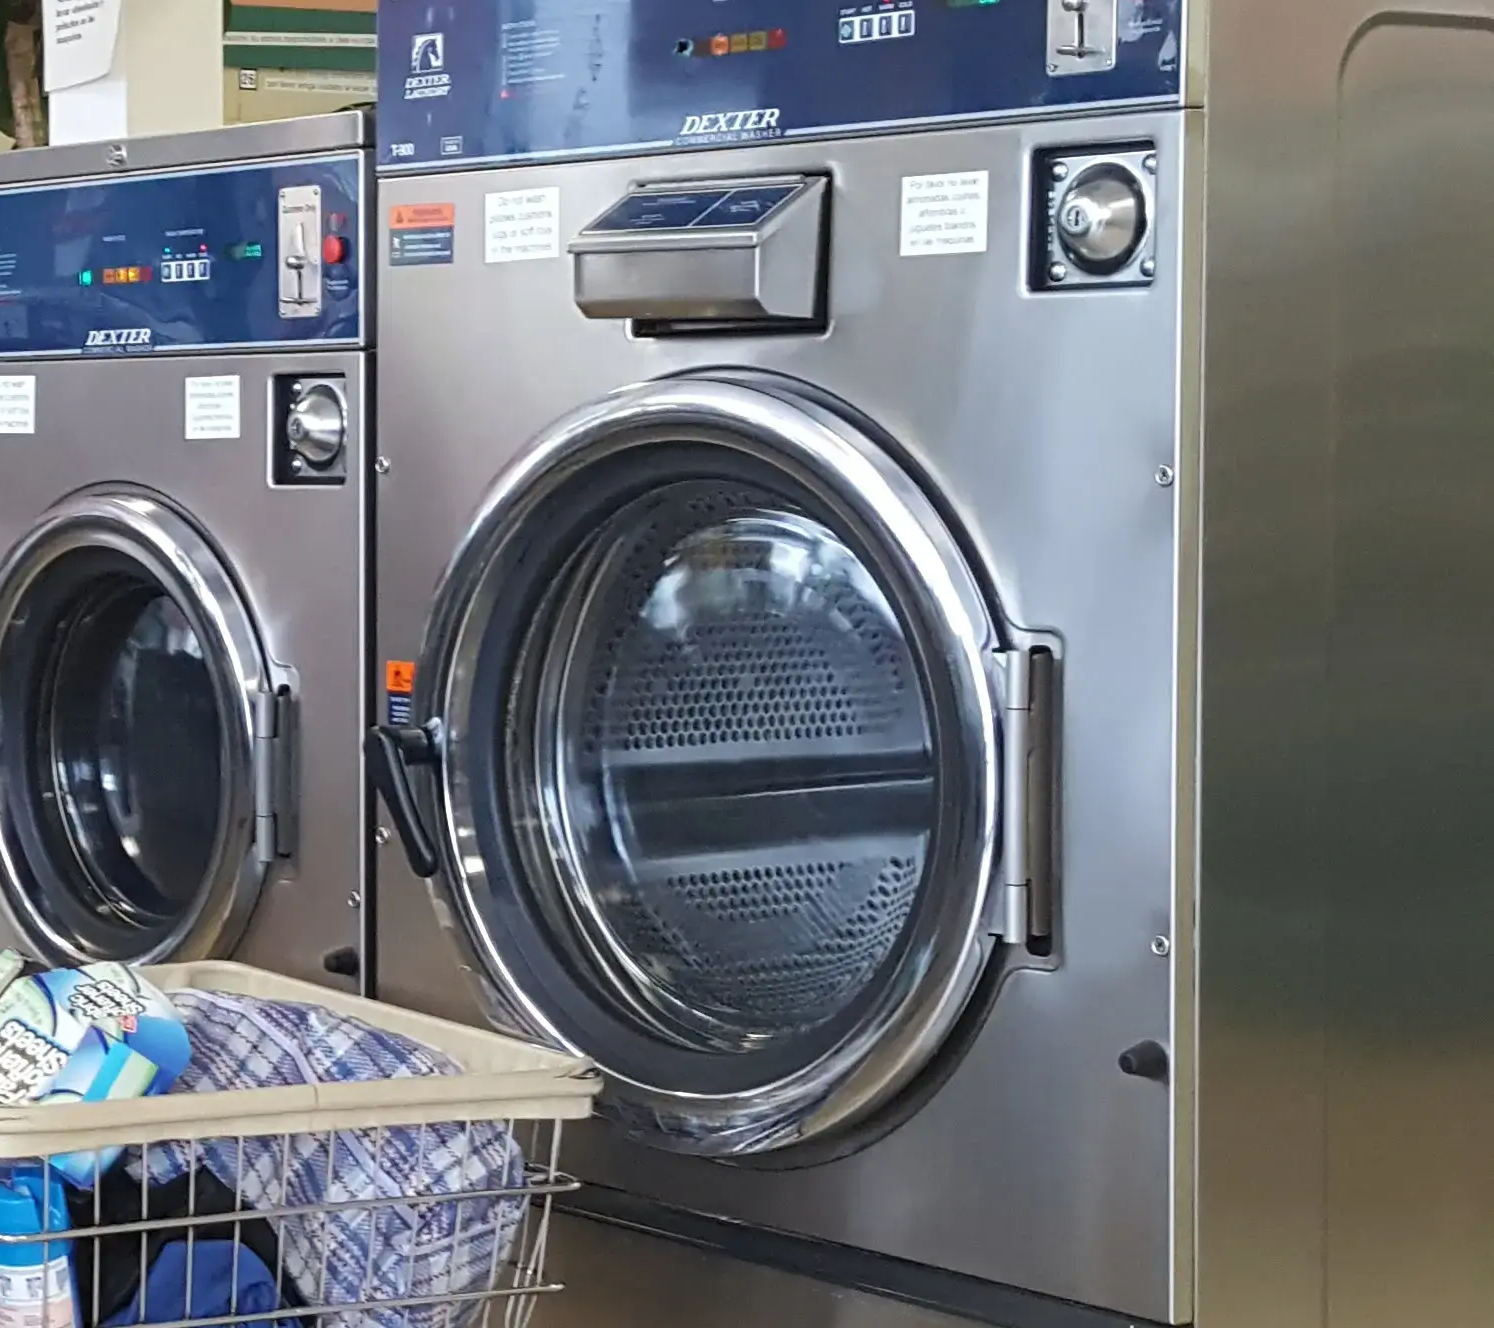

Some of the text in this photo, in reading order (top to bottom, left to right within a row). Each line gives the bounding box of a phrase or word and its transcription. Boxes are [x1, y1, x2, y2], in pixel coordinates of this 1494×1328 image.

[405, 74, 451, 88] DEXTER
[680, 108, 781, 136] DEXTER
[85, 328, 152, 346] DEXTER
[0, 1019, 68, 1075] Sheets
